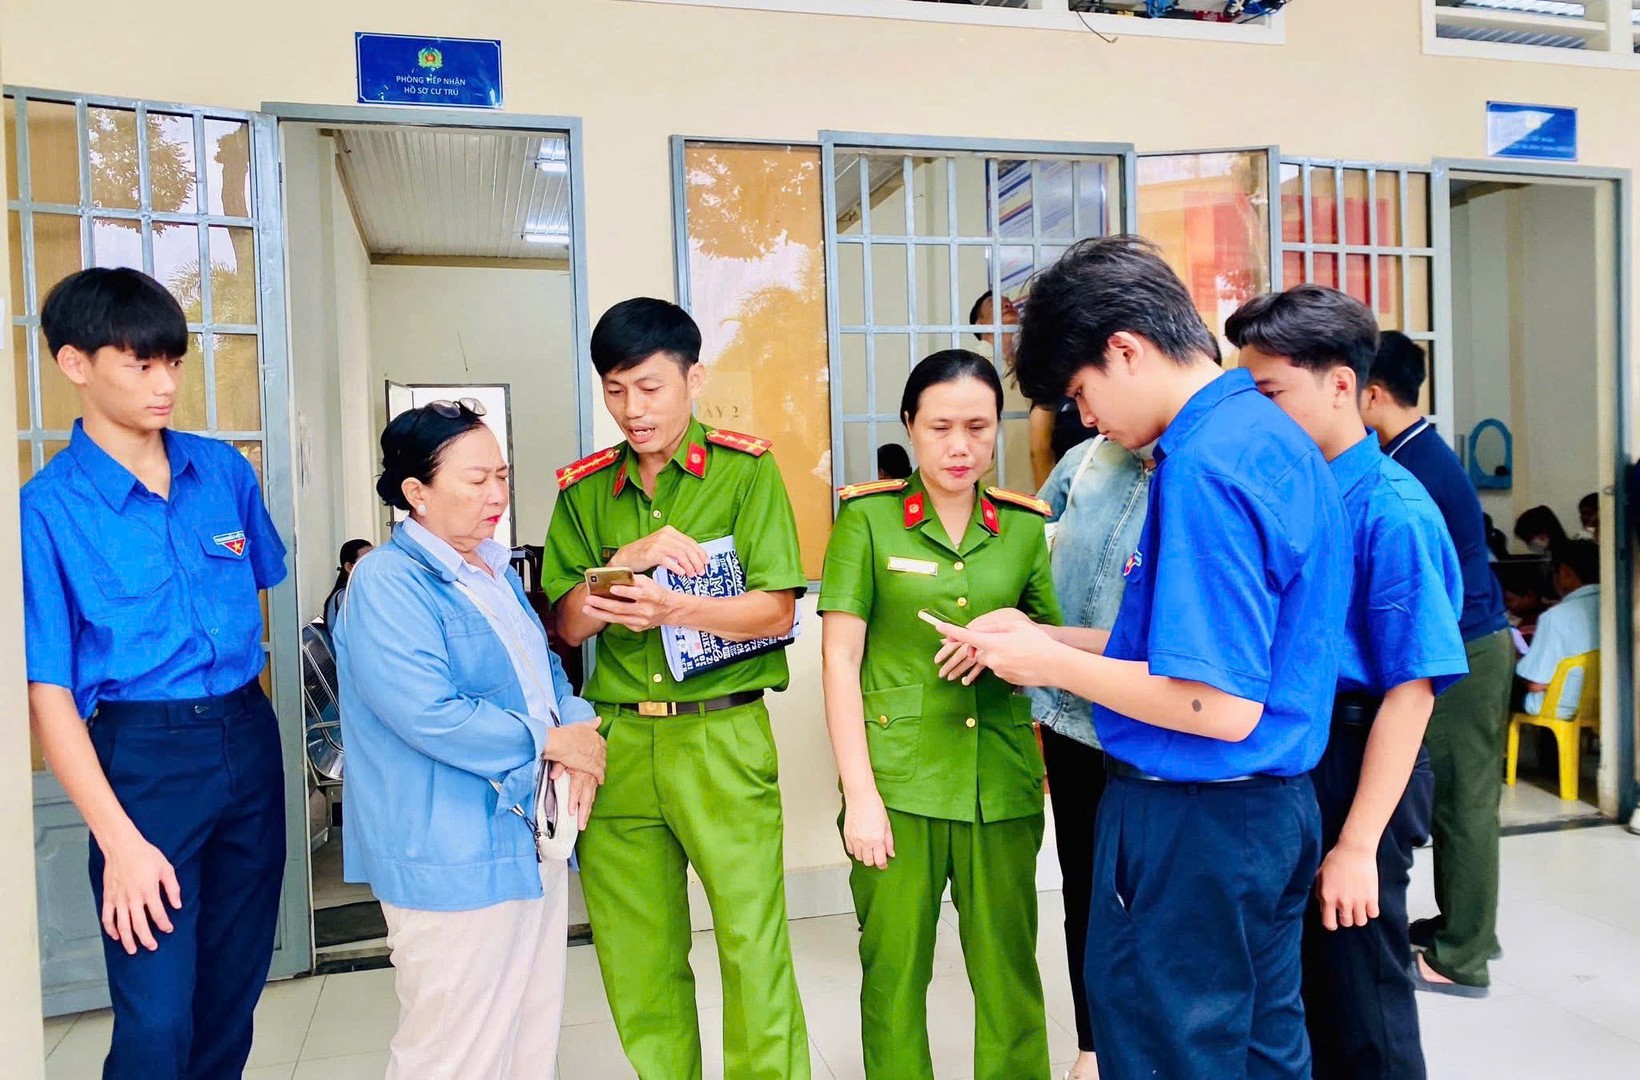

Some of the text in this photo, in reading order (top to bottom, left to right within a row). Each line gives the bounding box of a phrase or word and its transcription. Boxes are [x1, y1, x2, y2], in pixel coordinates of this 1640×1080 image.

[396, 74, 466, 87] PHÒNG TIẾP NHẬN
[404, 84, 459, 96] HỒ SƠ CƯ TRÚ
[732, 405, 740, 418] 2
[709, 576, 725, 597] M
